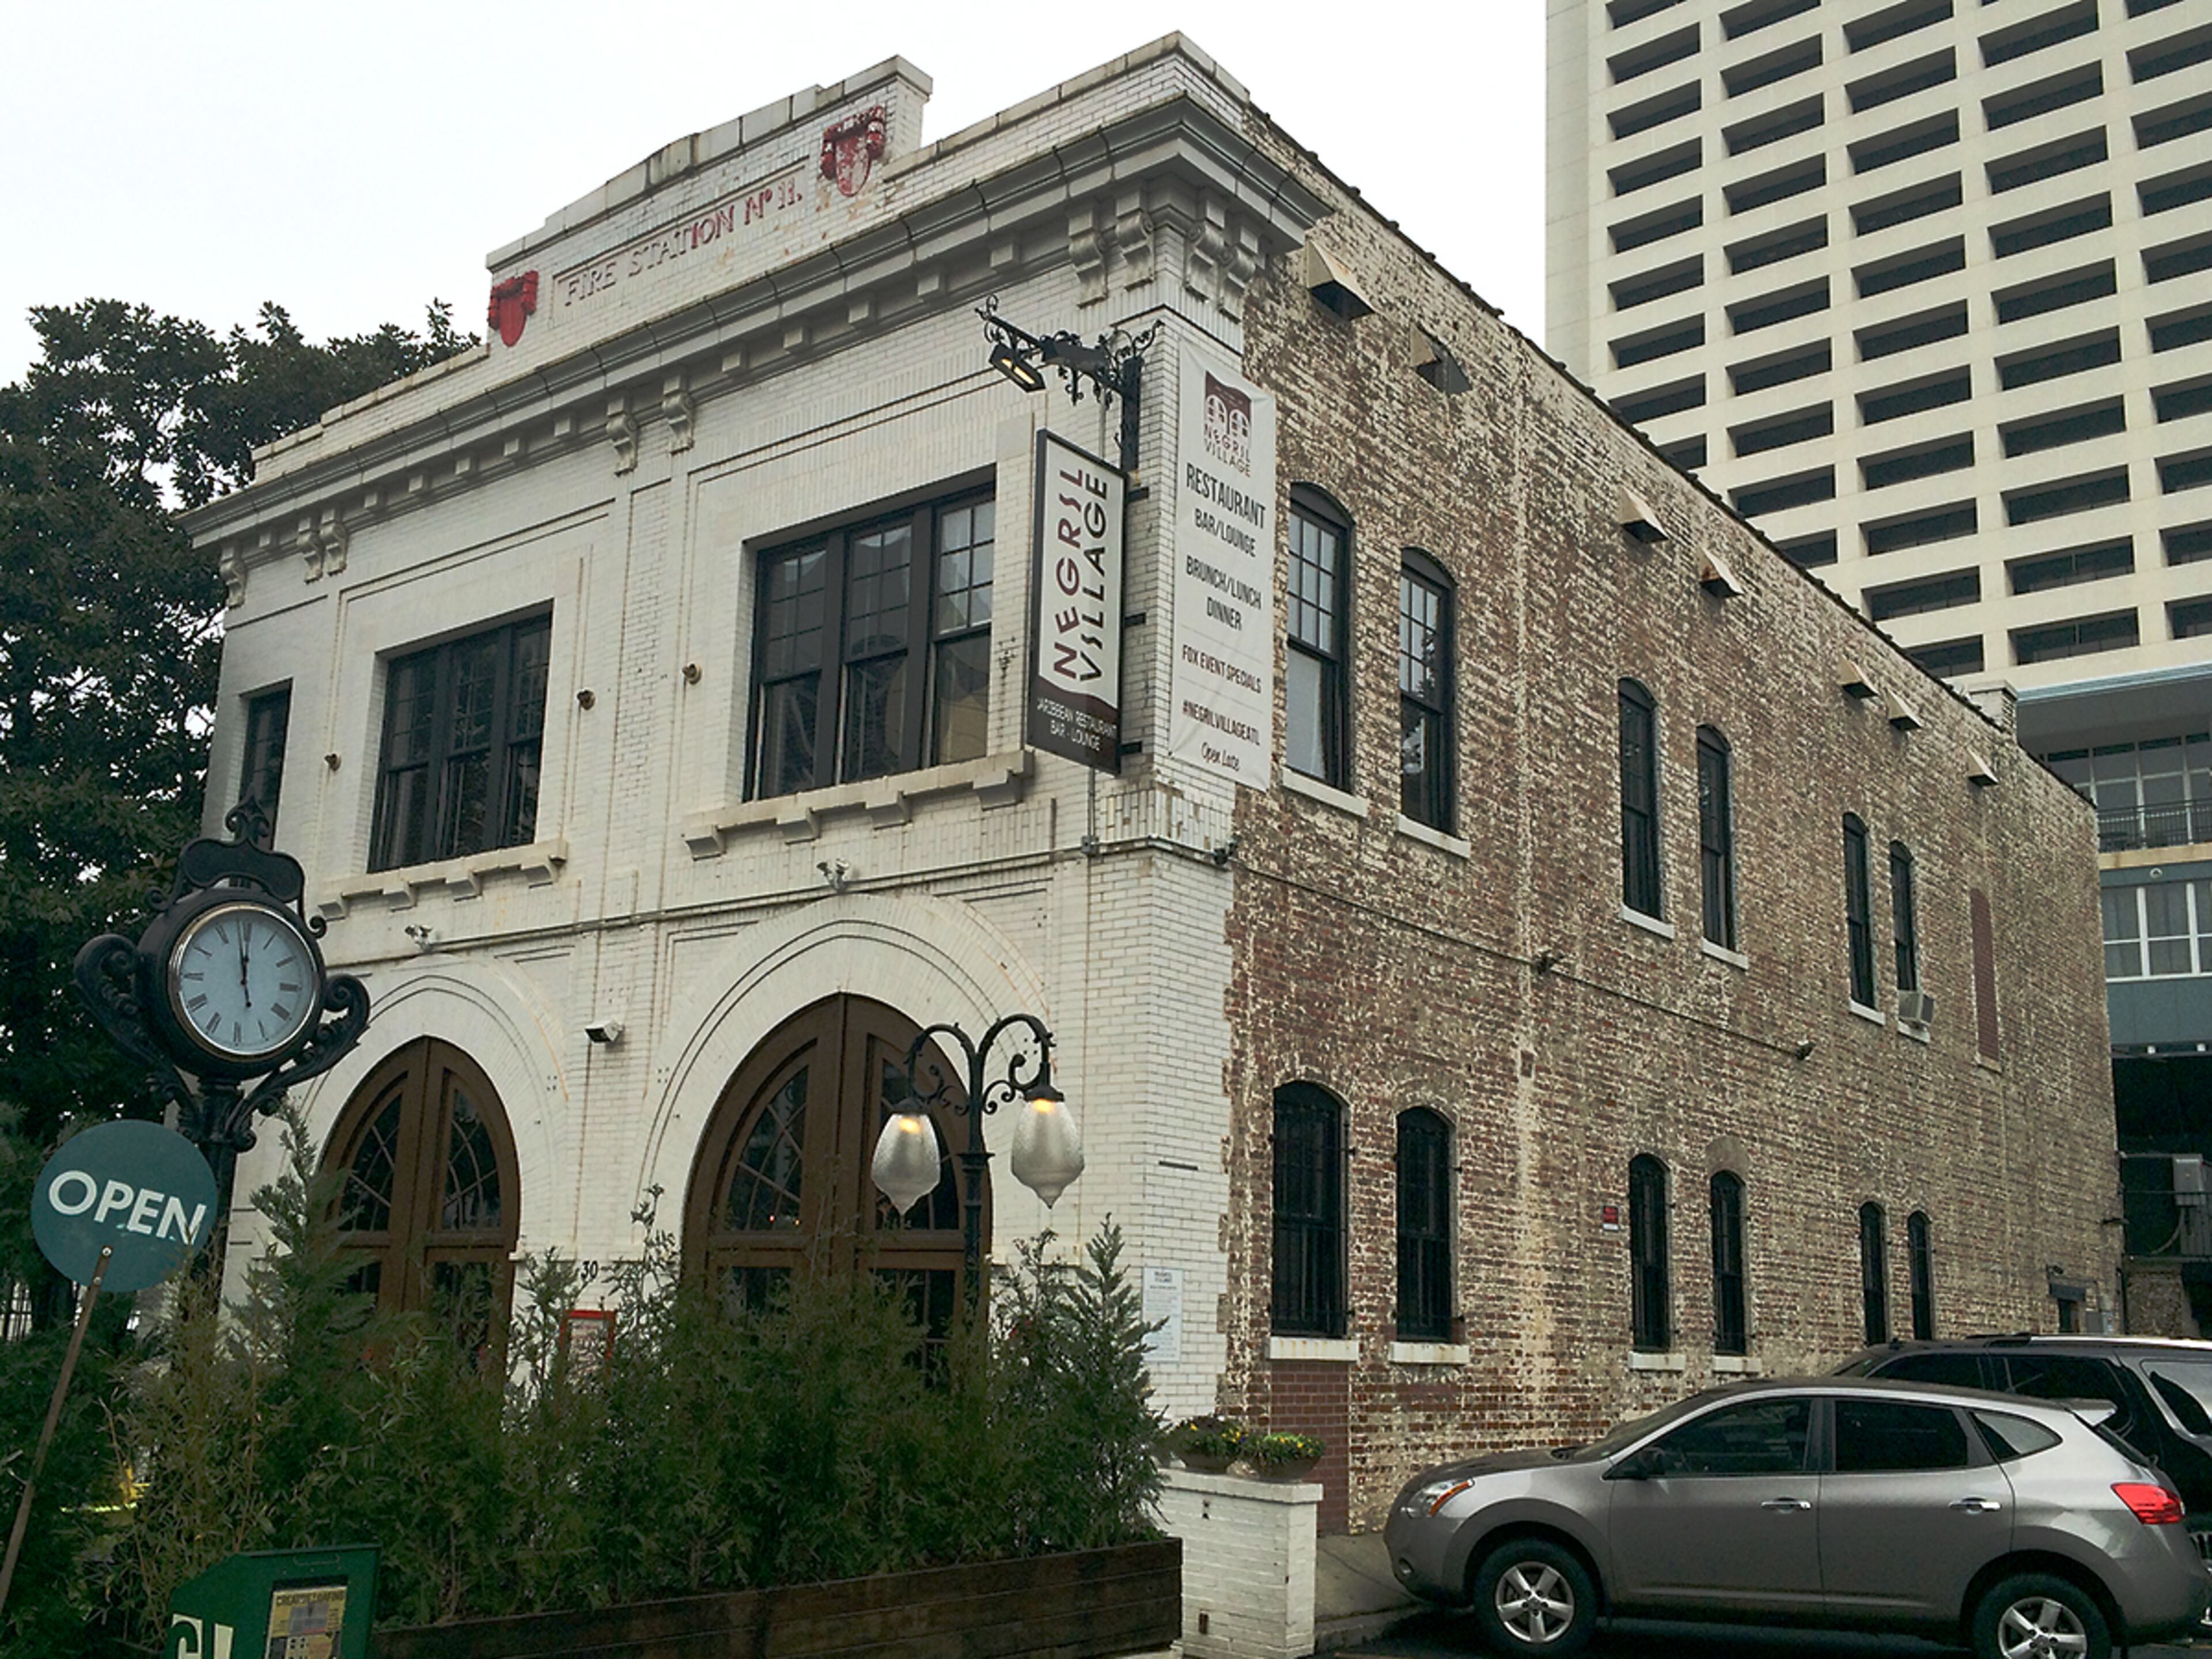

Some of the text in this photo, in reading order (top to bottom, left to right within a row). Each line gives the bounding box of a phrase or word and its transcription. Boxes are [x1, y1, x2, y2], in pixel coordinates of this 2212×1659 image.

[565, 262, 616, 306] FIRE
[628, 204, 734, 277] STATION
[1205, 438, 1250, 478] VILLAGE
[1187, 463, 1266, 529] RESTAURANT
[1195, 508, 1256, 558] BAR/LOUNGE
[1079, 473, 1107, 682] VILLAGE
[1187, 555, 1262, 610] BRUNCH/LUNCH
[1207, 597, 1241, 631] DINNER
[1183, 645, 1261, 694] FOX EVENT SPECIALS
[1050, 719, 1100, 751] BAR LOUNGE
[1202, 742, 1240, 771] Open Late
[48, 1170, 207, 1245] OPEN
[581, 1260, 598, 1279] 30
